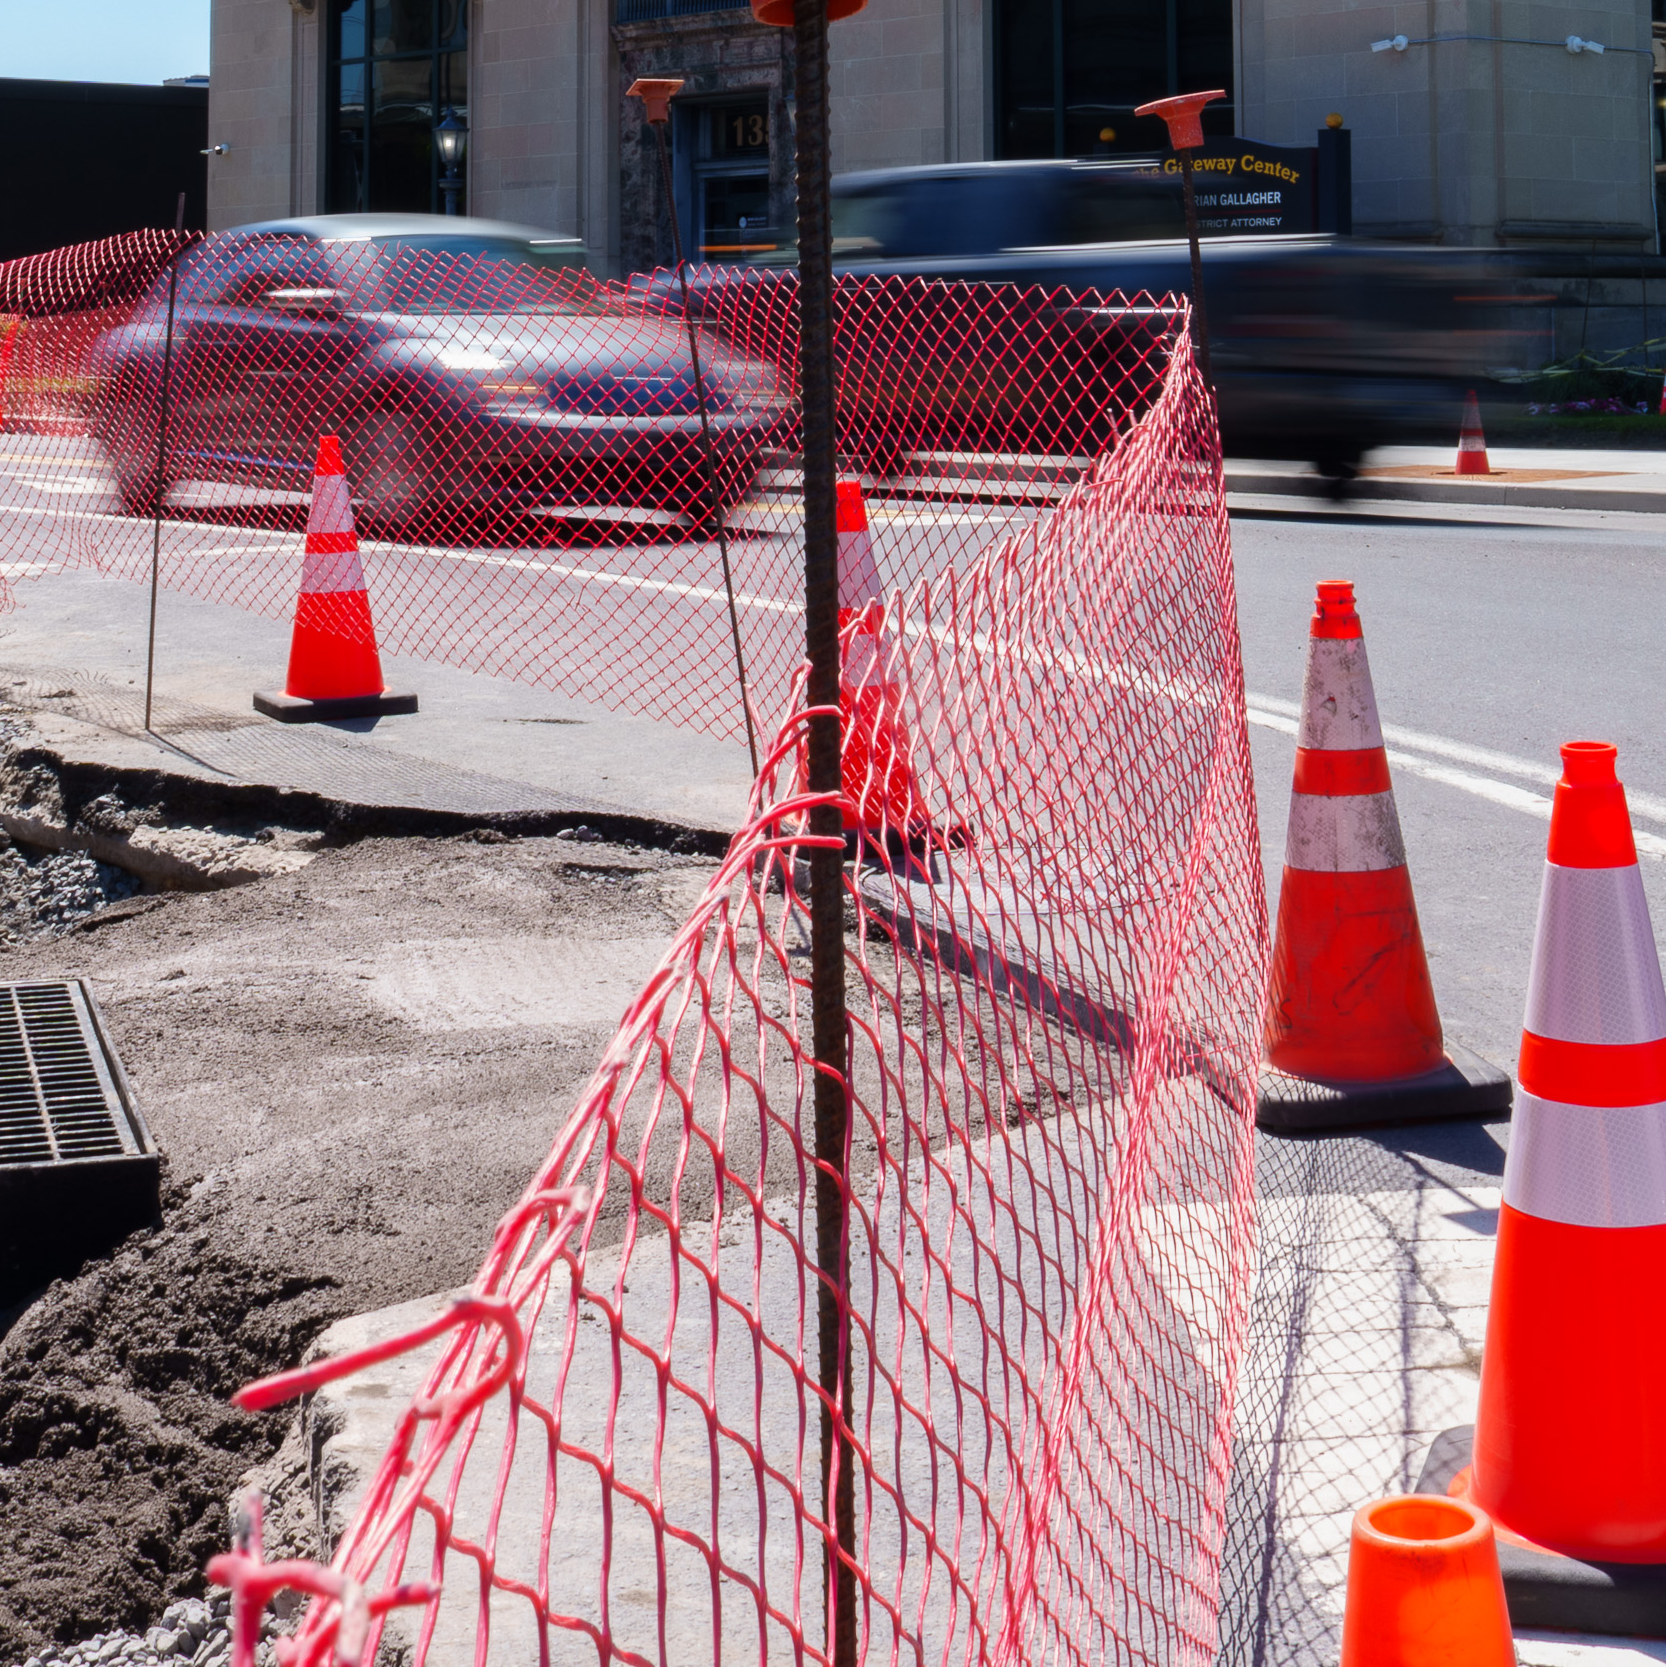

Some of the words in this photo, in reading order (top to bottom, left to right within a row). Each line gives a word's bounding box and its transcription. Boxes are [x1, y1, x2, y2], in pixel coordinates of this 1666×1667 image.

[1164, 157, 1237, 174] Gaeway
[1240, 154, 1300, 184] Center
[1194, 195, 1217, 206] RIAN
[1219, 191, 1282, 206] GALLAGHER
[1196, 219, 1228, 229] STRICT
[1230, 217, 1282, 228] ATTORNEY
